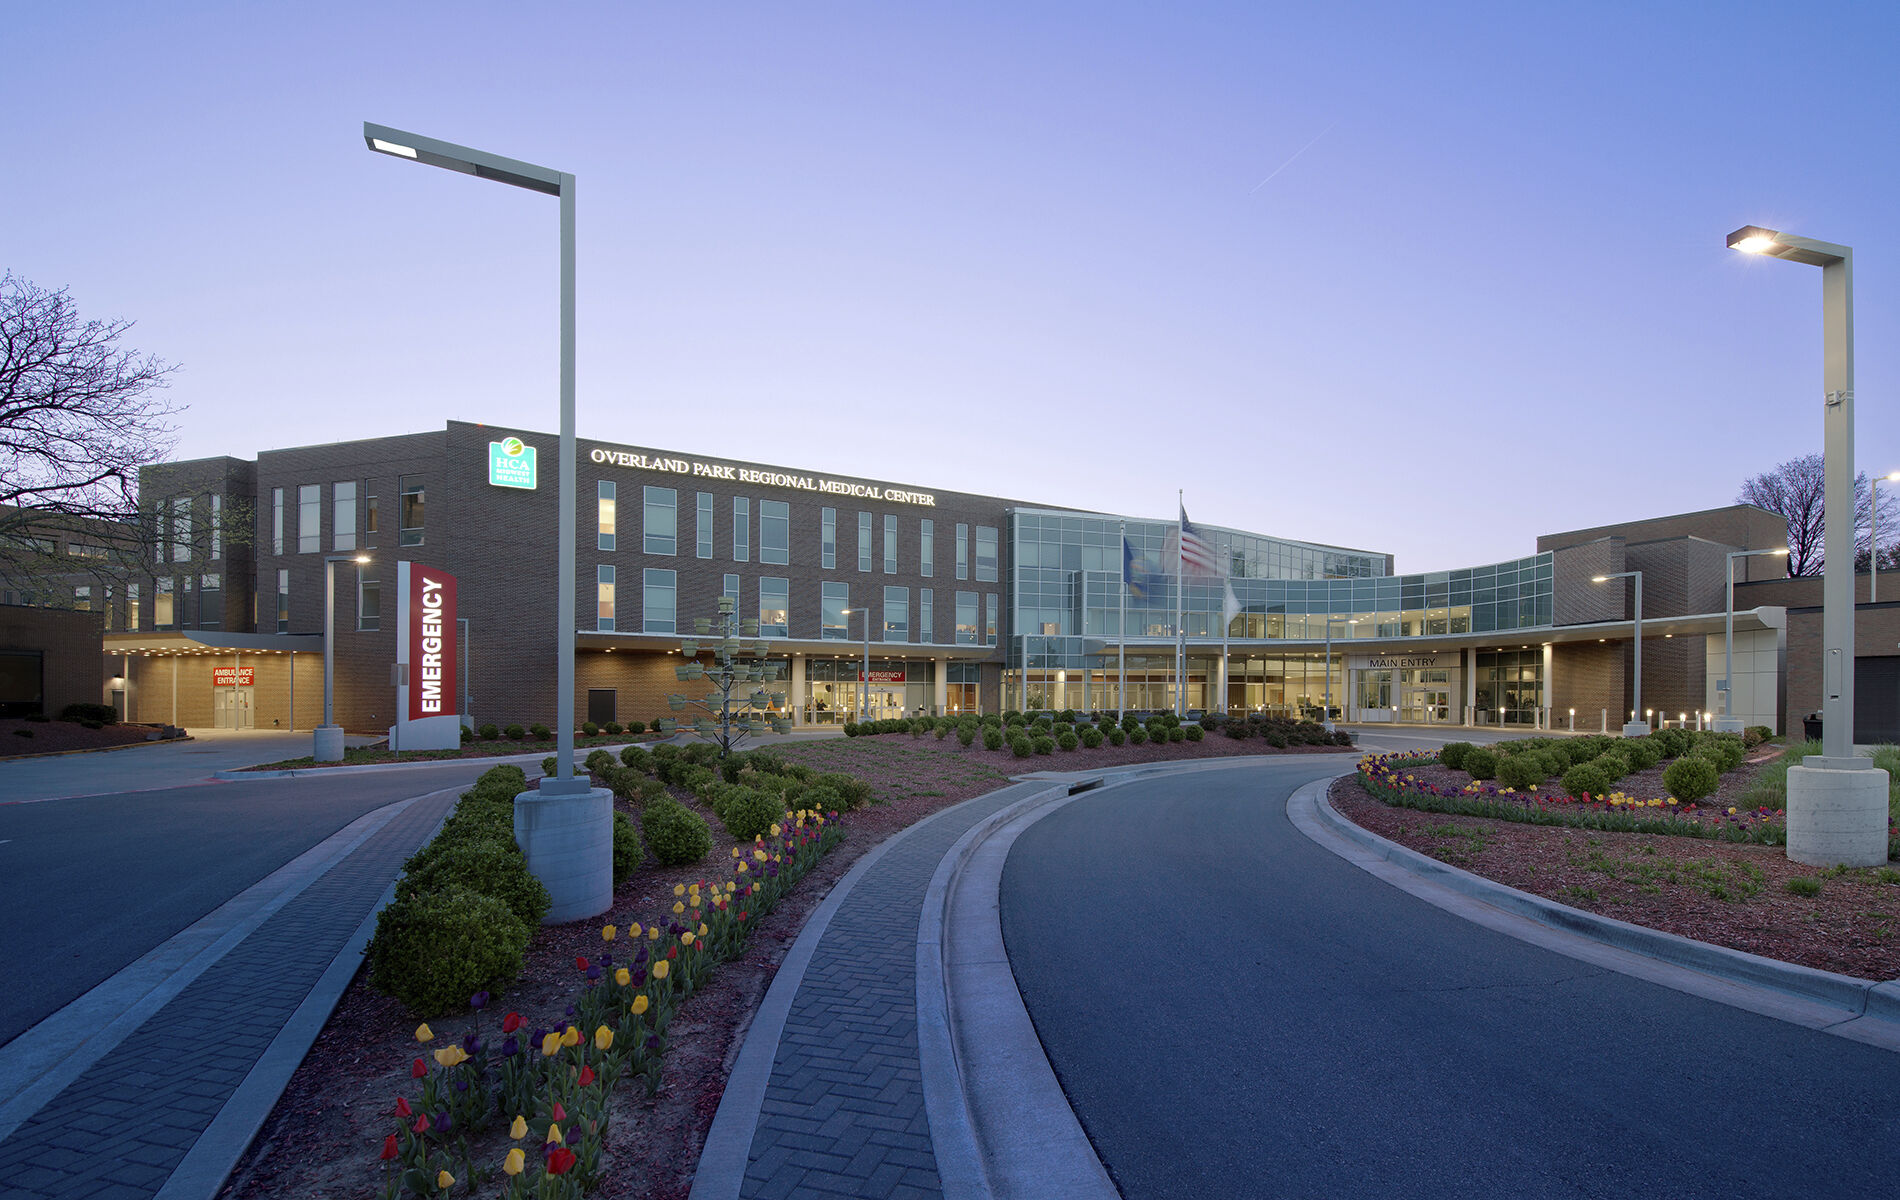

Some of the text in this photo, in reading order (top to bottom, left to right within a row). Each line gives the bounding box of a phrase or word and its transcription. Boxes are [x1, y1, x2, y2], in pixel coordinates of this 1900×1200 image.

[496, 457, 530, 470] HCA
[496, 475, 530, 484] HEALTH
[590, 449, 936, 506] OVERLAND PARK REGIONAL MEDICAL CENTER
[421, 577, 443, 713] EMERGENCY
[1369, 658, 1436, 668] MAIN ENTRY
